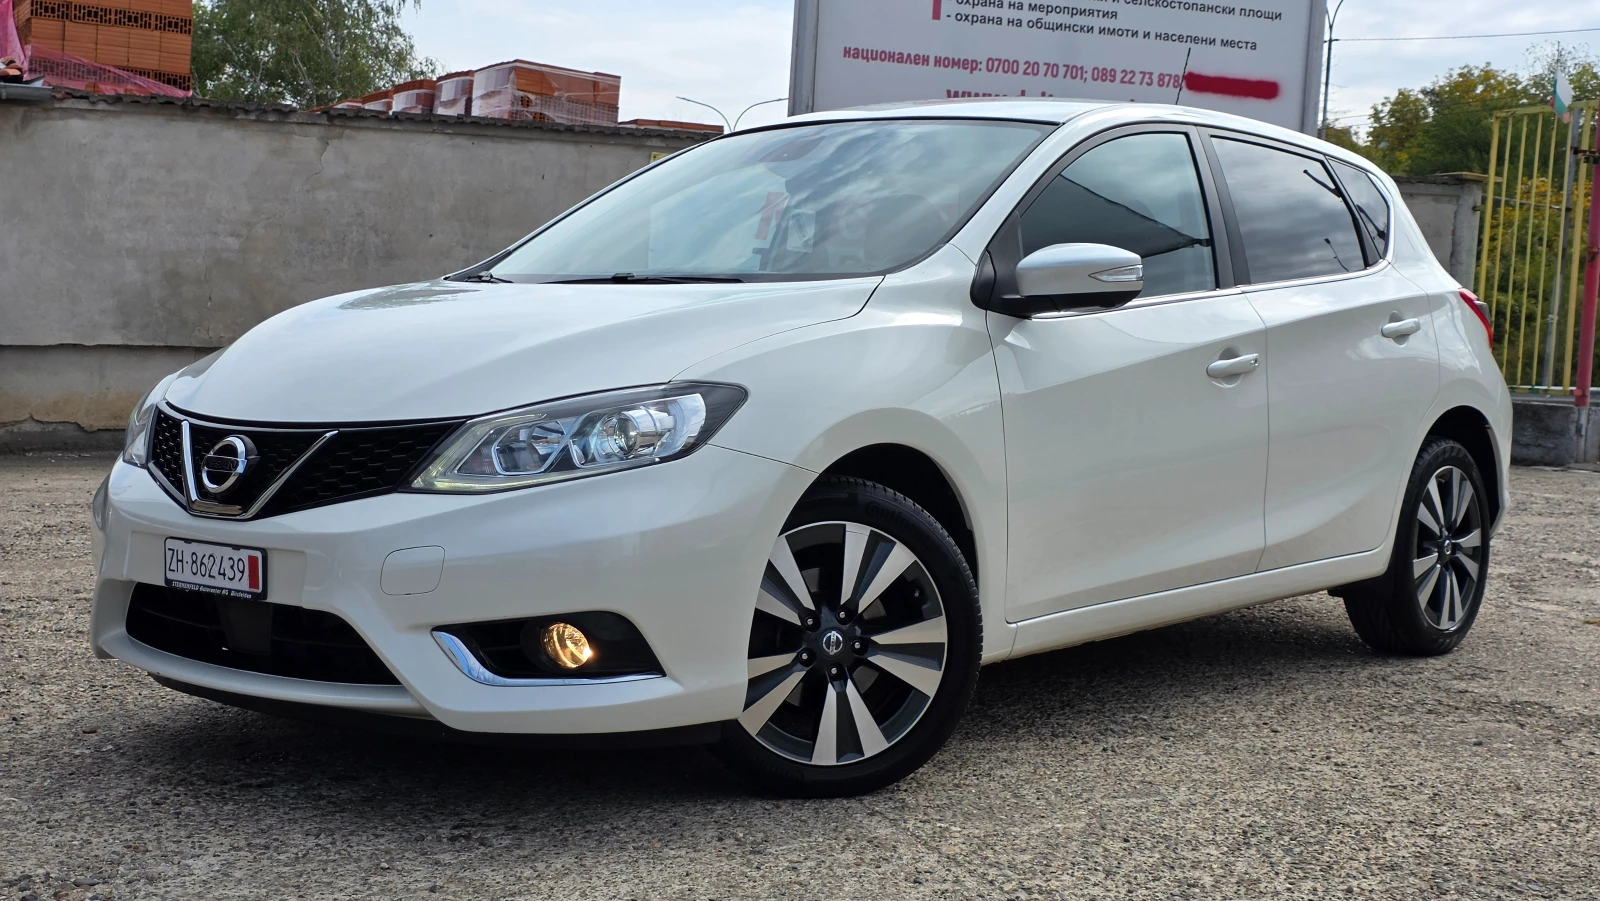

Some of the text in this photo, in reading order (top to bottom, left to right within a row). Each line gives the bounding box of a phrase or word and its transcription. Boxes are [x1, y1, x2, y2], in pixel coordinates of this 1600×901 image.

[1008, 1, 1024, 11] на
[1028, 4, 1118, 20] мероприятия
[1239, 7, 1282, 21] площи
[955, 12, 1003, 26] охрана
[1007, 17, 1023, 28] на
[1027, 18, 1094, 34] общински
[1098, 26, 1139, 39] имоти
[1143, 29, 1151, 40] и
[1155, 31, 1216, 46] населени
[1220, 38, 1257, 51] места
[843, 46, 930, 67] национален
[934, 55, 983, 74] номер:
[986, 57, 1019, 75] 0700
[1022, 60, 1040, 76] 20
[1043, 62, 1059, 78] 70
[1063, 64, 1088, 83] 701;
[1091, 66, 1117, 83] 089
[1120, 69, 1136, 85] 22
[1139, 71, 1154, 87] 73
[172, 580, 200, 591] STERNENFELD
